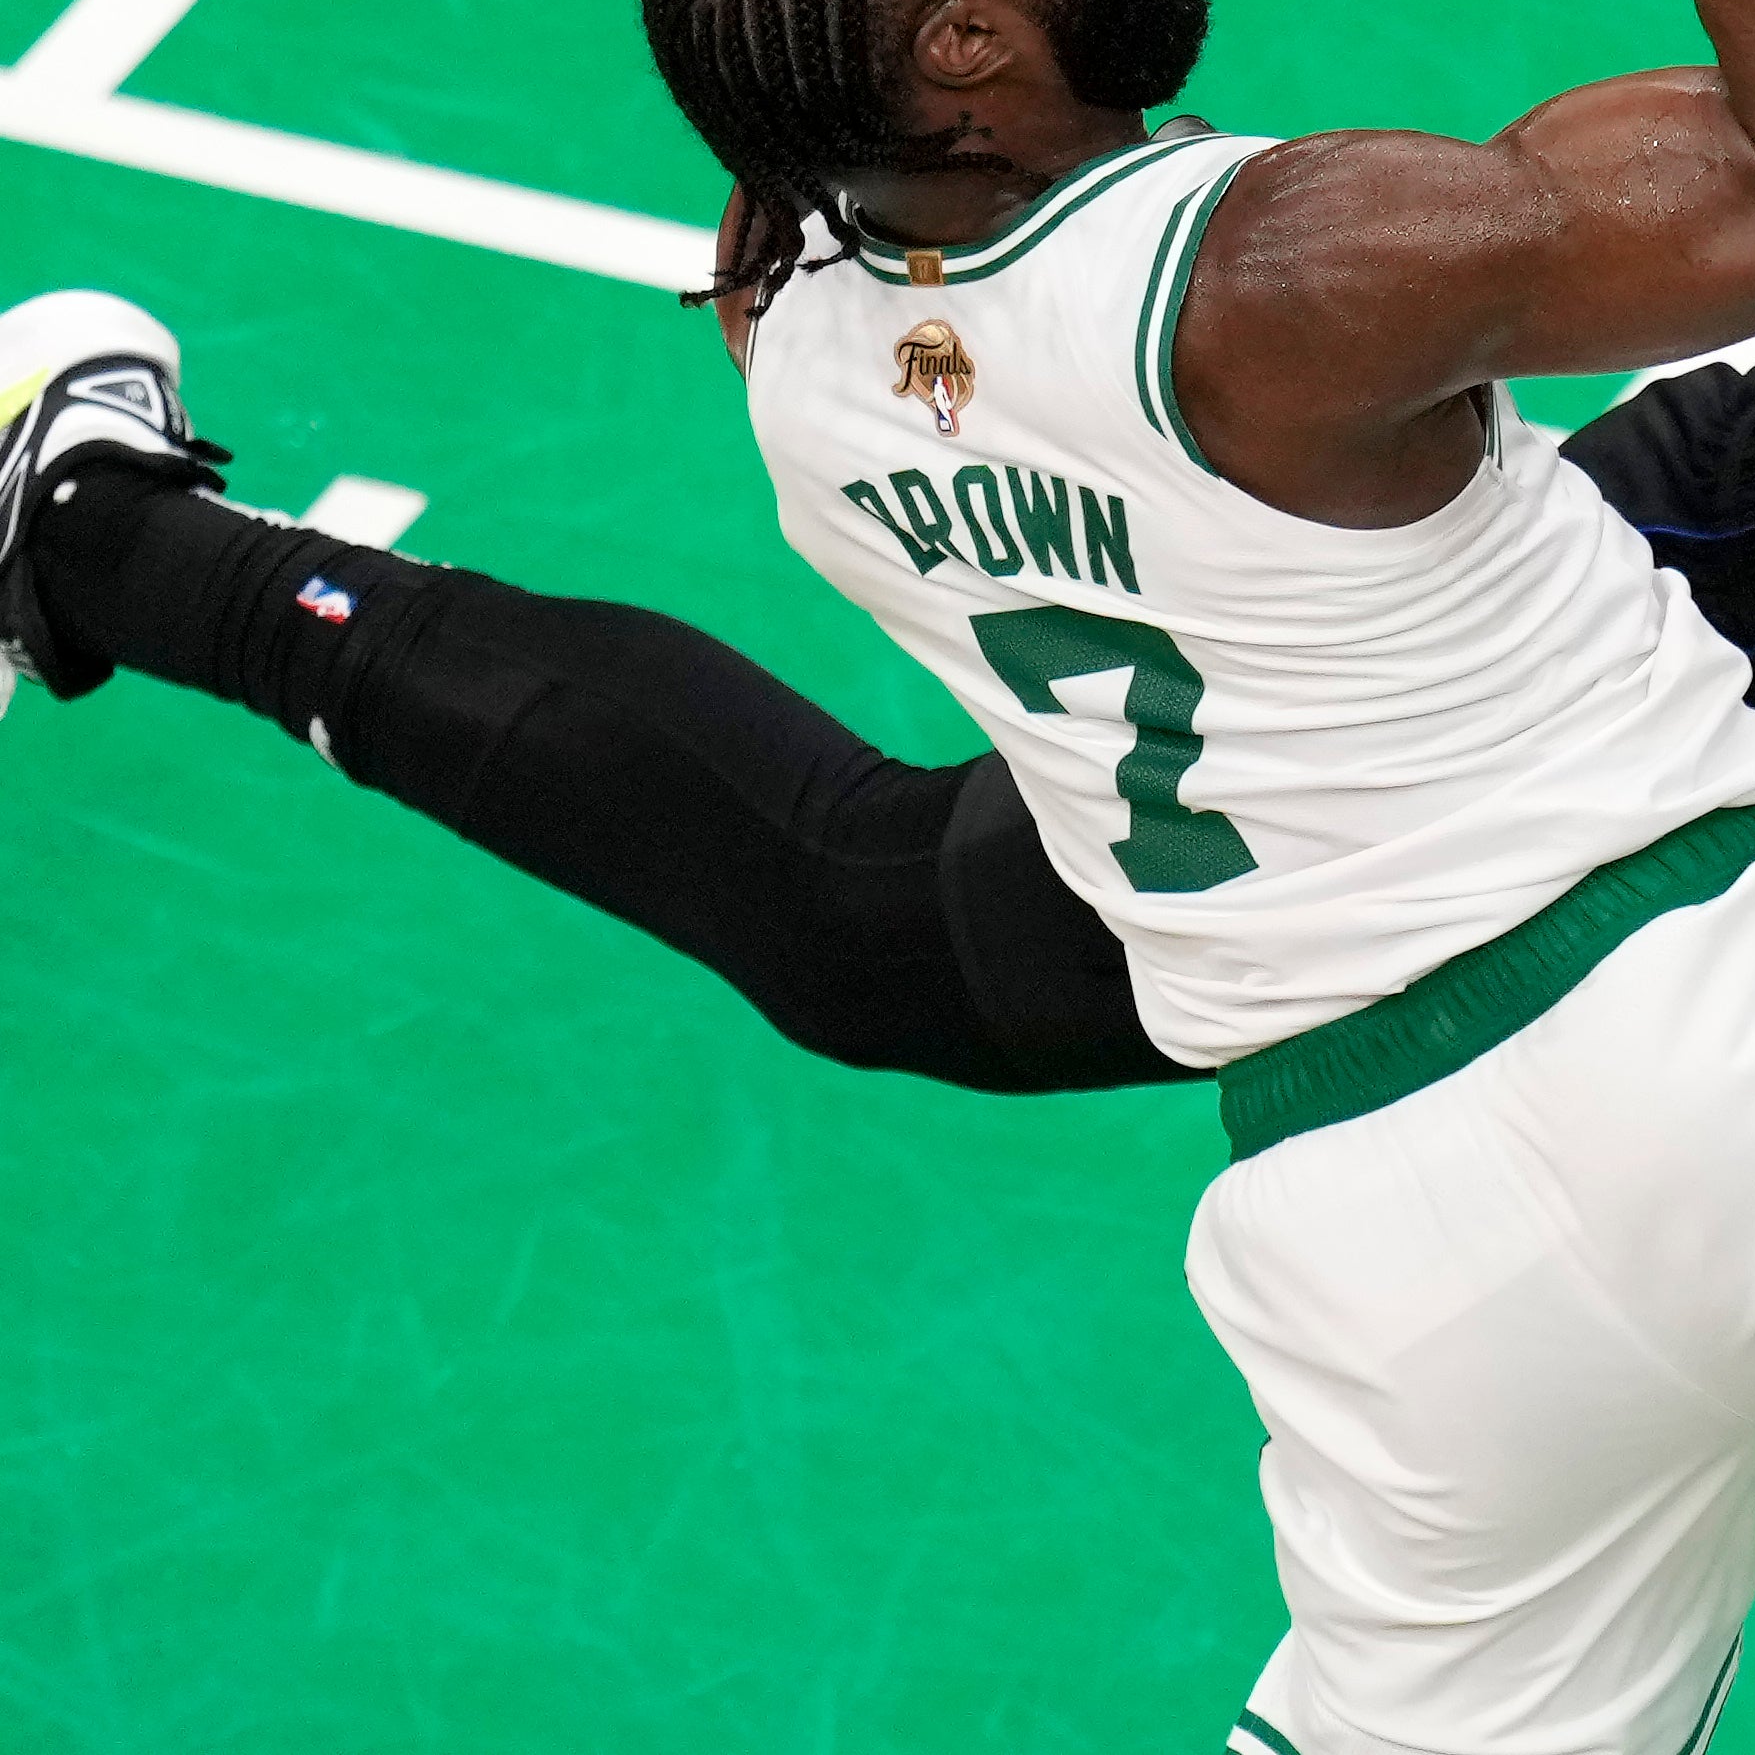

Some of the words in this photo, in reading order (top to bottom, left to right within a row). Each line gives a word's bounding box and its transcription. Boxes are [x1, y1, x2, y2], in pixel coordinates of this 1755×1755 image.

[898, 340, 971, 394] Finals
[842, 463, 1142, 596] BROWN
[968, 604, 1259, 894] 7
